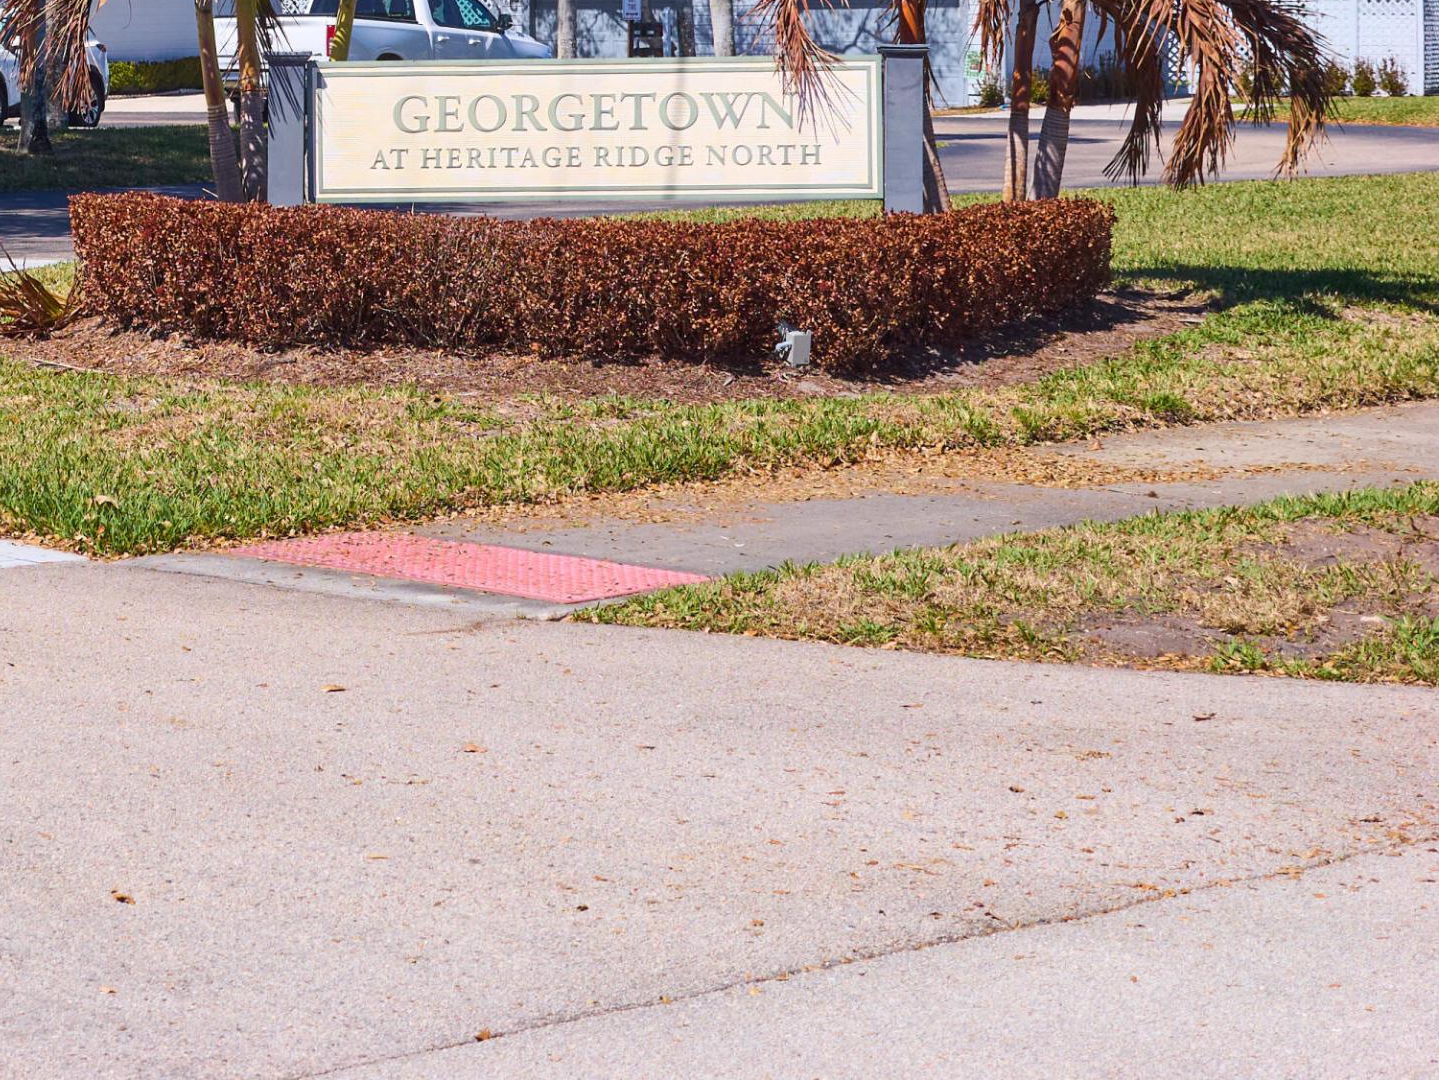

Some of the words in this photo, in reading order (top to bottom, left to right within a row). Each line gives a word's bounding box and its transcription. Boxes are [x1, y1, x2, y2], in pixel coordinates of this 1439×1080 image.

[392, 91, 800, 134] GEORGETOWN
[369, 148, 409, 170] AT
[420, 146, 582, 169] HERITAGE
[593, 145, 694, 168] RIDGE
[705, 144, 822, 167] NORTH
